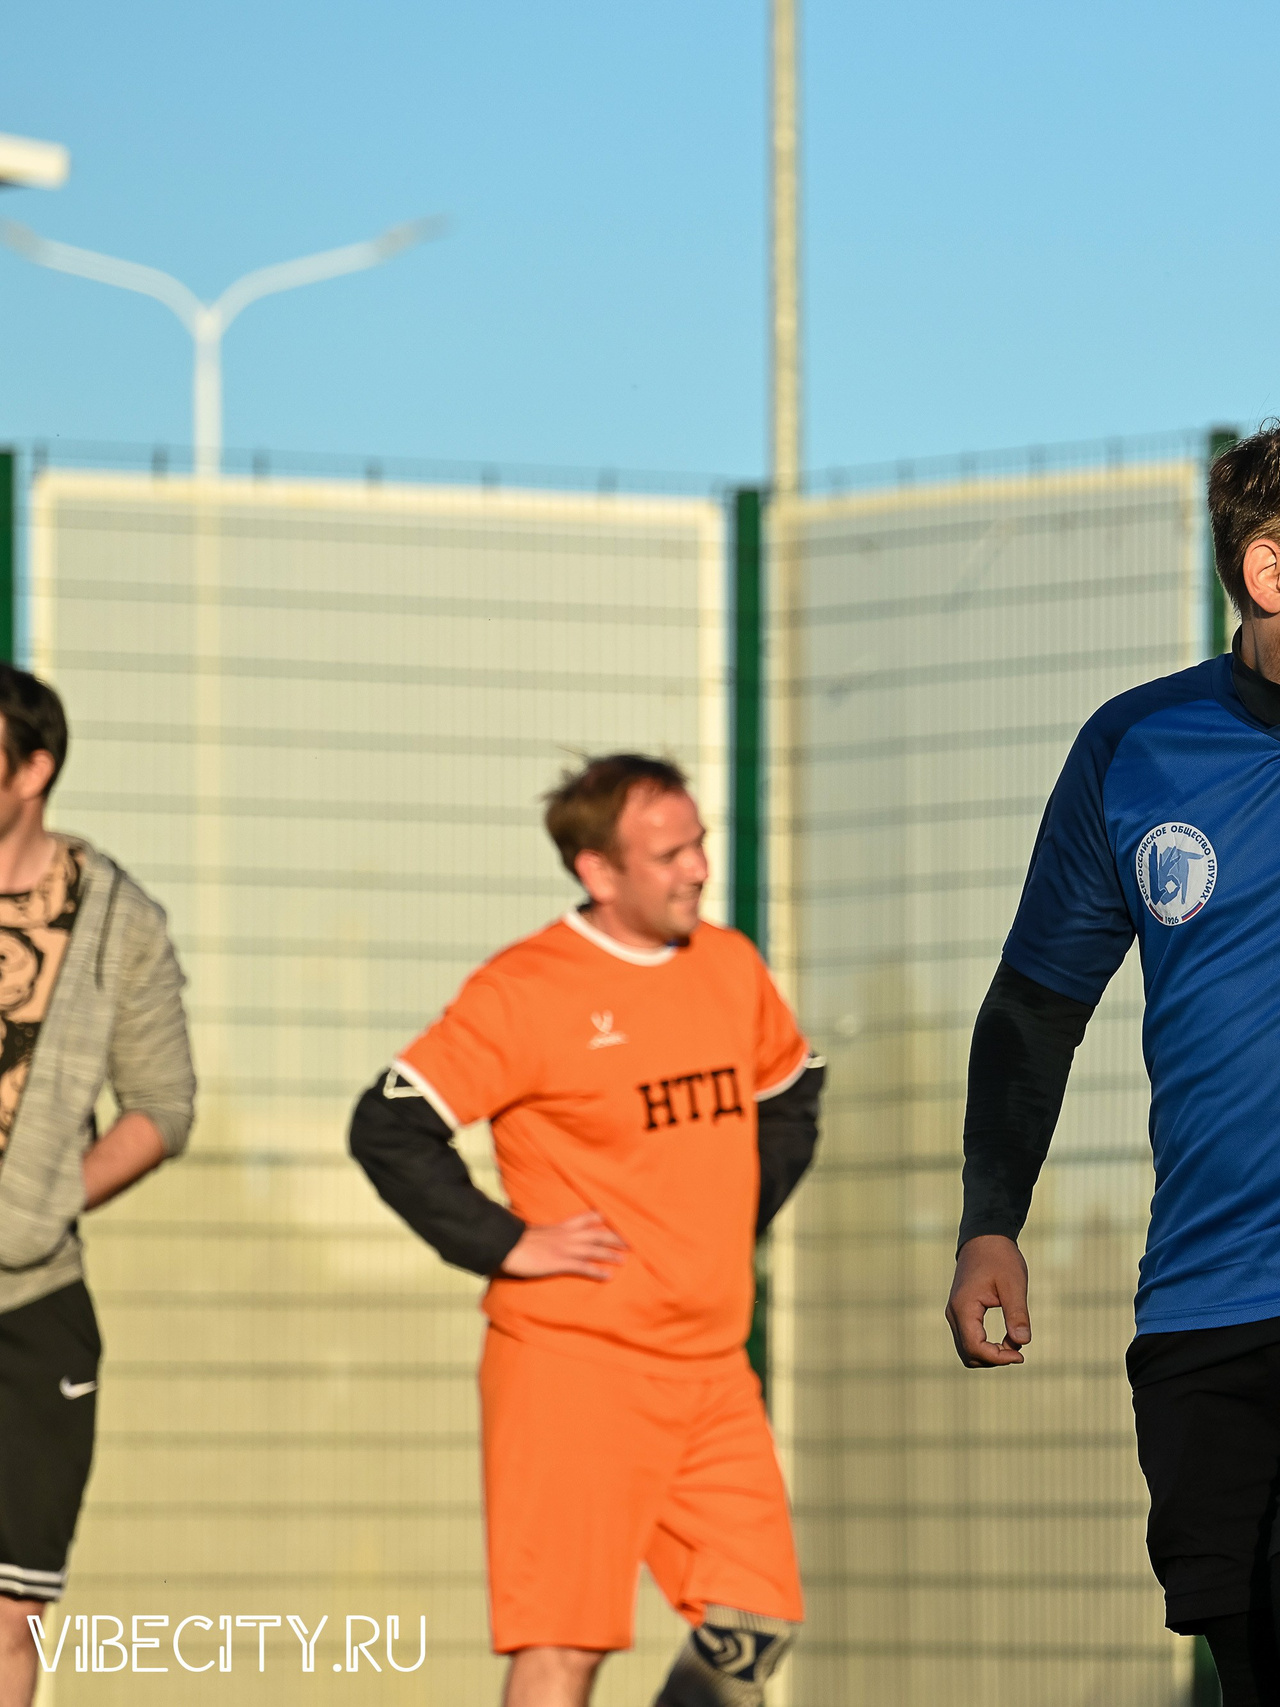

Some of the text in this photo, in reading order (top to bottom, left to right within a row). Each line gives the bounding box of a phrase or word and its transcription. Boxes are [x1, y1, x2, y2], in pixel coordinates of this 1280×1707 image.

[1137, 825, 1216, 901] ВСЕРОССИЙСКОЕ ОБЩЕСТВО ГЛУХИХ
[1164, 916, 1179, 925] 1926
[635, 1066, 744, 1132] НТД
